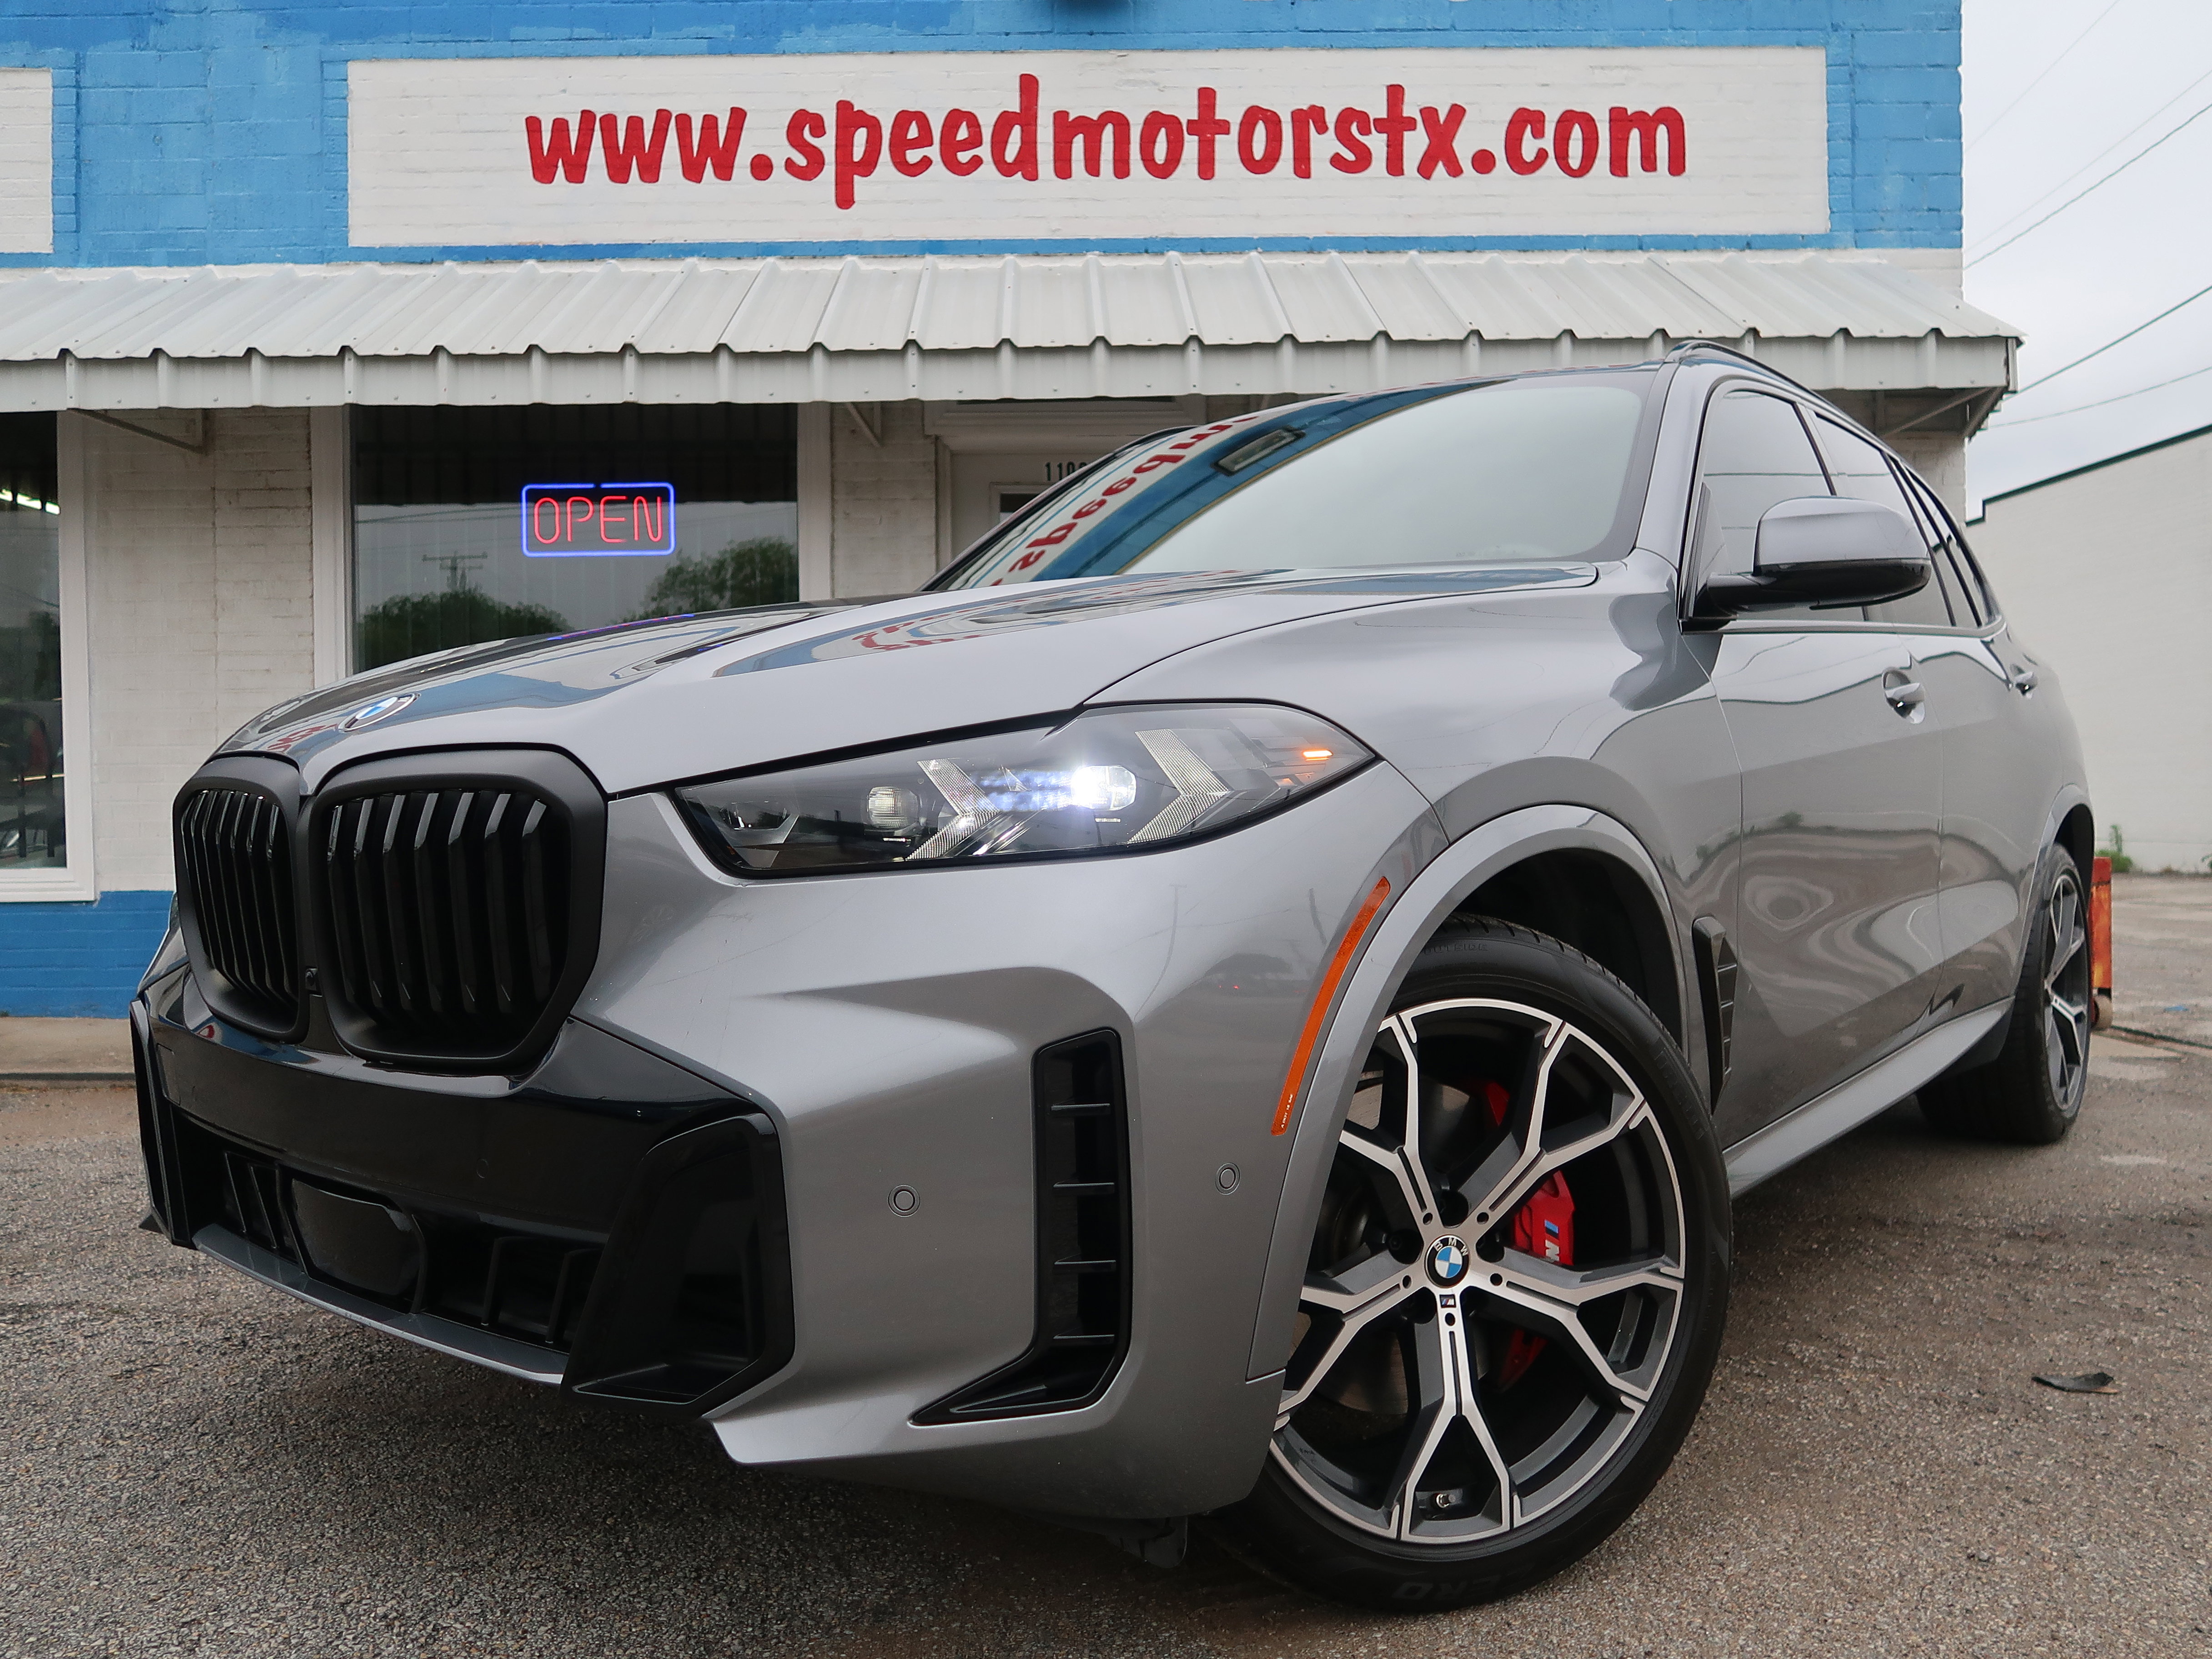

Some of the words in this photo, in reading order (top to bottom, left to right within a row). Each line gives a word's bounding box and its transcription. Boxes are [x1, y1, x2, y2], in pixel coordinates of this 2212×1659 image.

[525, 73, 1686, 211] www.speedmotorstx.com
[1045, 461, 1087, 481] 110
[533, 496, 663, 544] OPEN
[1433, 1237, 1468, 1256] BMW
